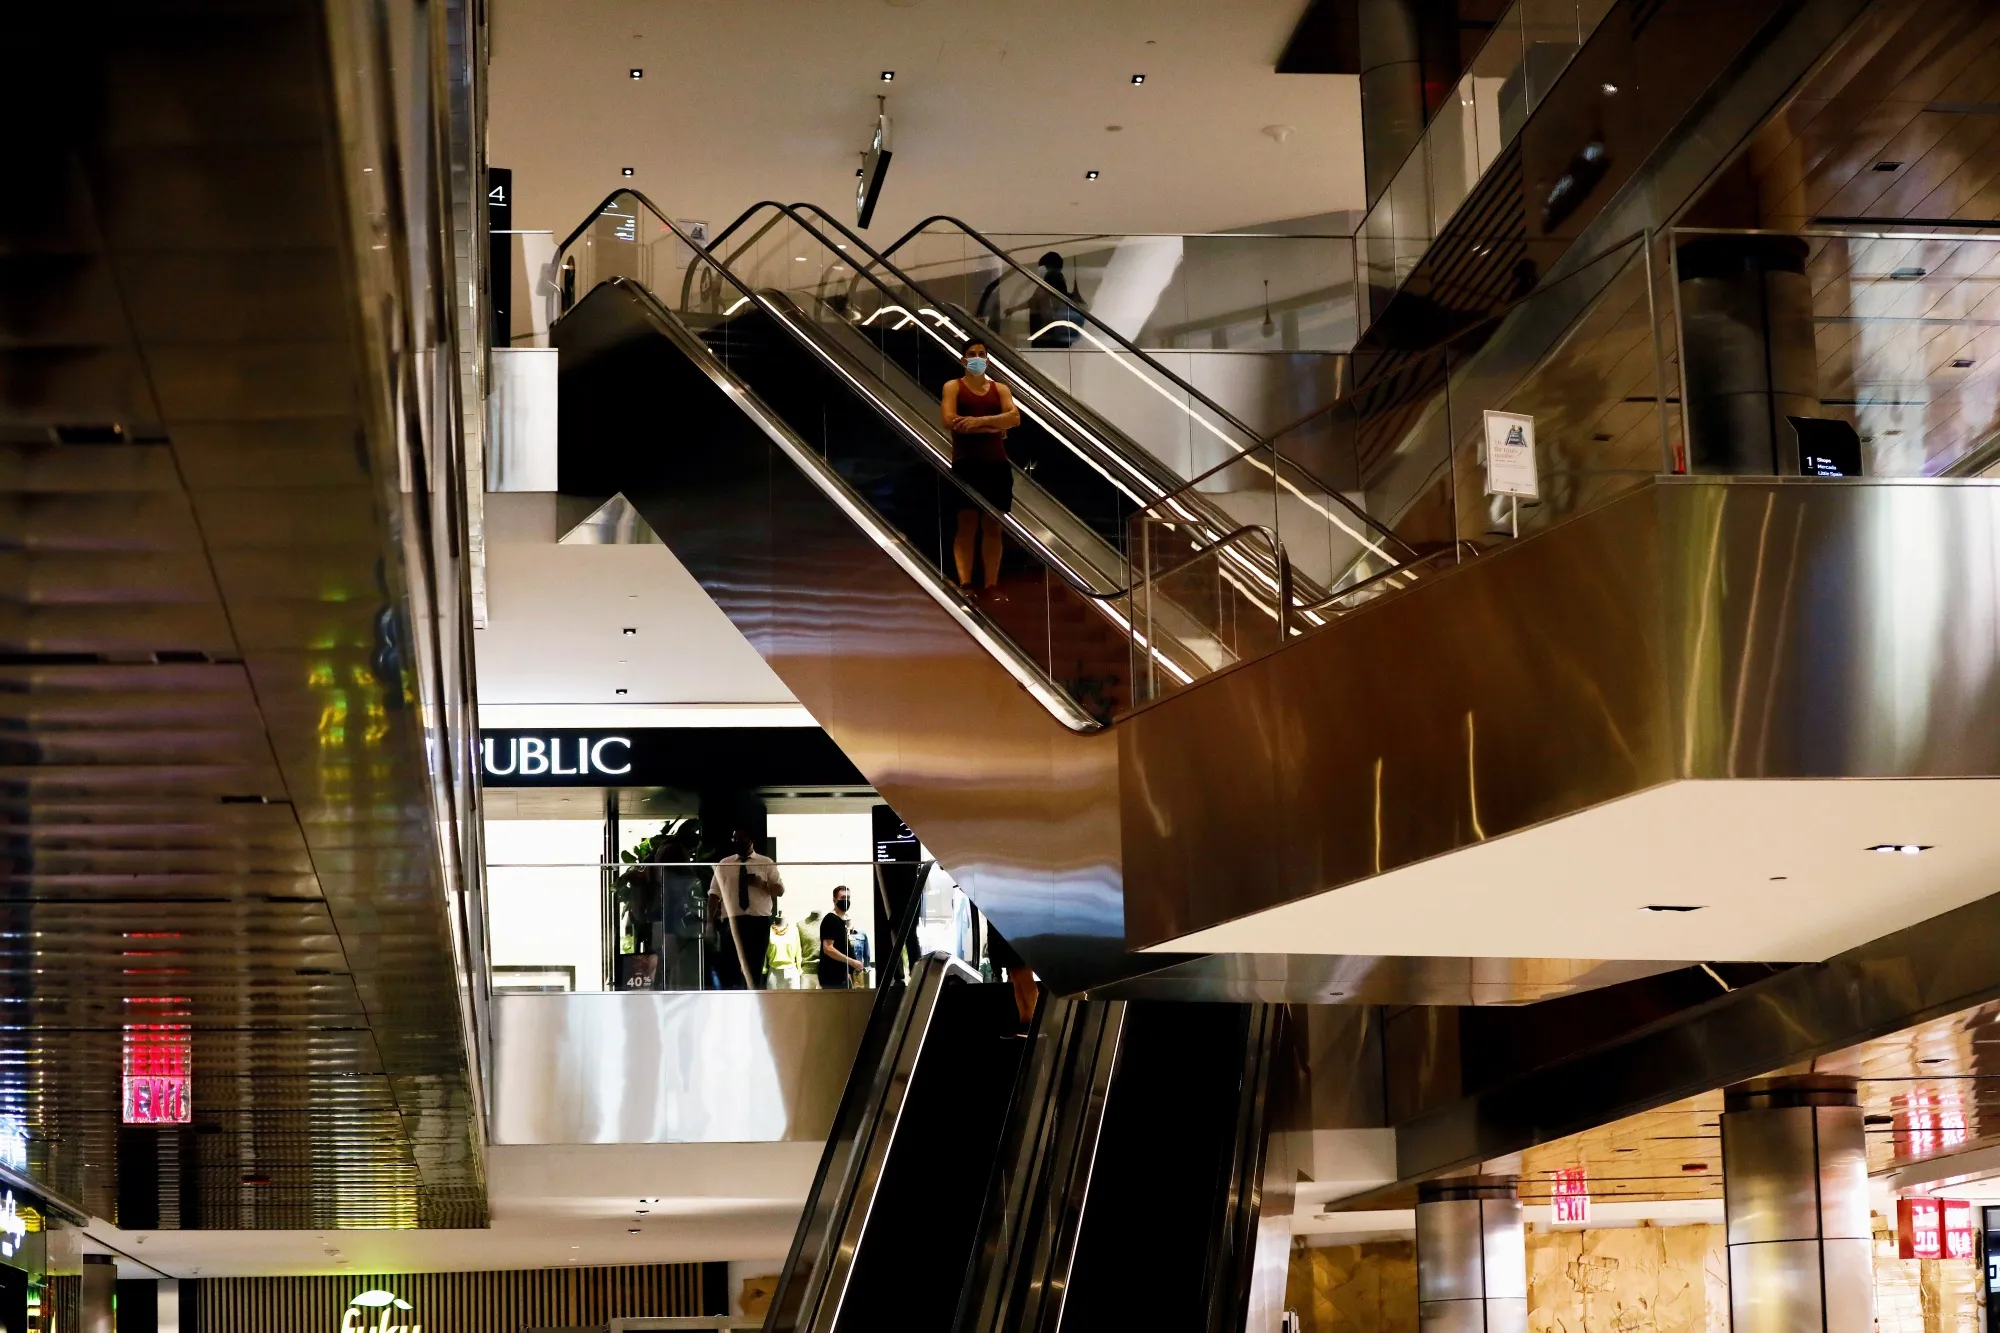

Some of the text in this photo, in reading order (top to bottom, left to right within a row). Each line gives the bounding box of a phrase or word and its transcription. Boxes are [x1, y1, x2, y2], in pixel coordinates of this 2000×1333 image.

[488, 185, 506, 202] 4
[132, 1078, 185, 1119] EXIT
[1556, 1197, 1587, 1221] EXIT
